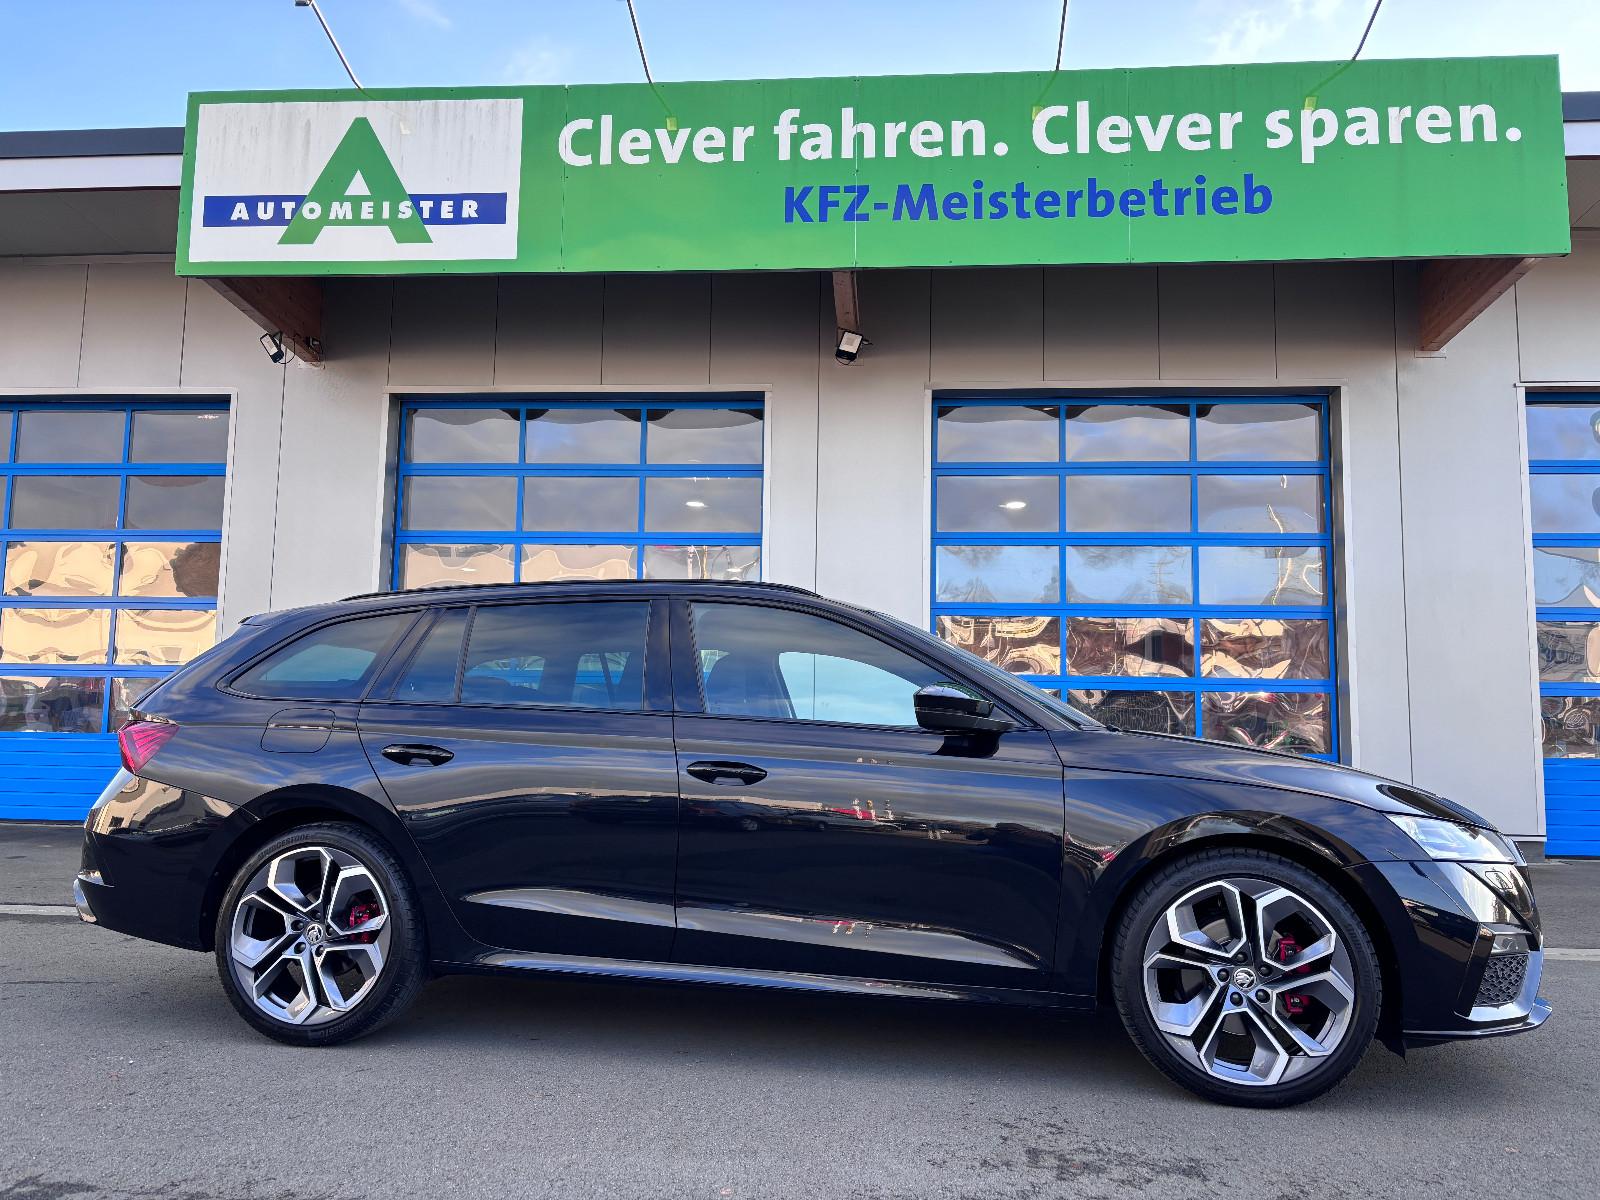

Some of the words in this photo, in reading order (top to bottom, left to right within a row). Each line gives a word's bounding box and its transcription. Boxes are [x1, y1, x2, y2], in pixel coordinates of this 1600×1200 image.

[558, 114, 755, 167] Clever
[773, 106, 1009, 162] fahren.
[1031, 100, 1243, 155] Clever
[1265, 103, 1522, 165] sparen.
[277, 116, 433, 245] A
[785, 174, 1273, 224] KFZ-Meisterbetrieb
[229, 199, 481, 222] AUTOMEISTER
